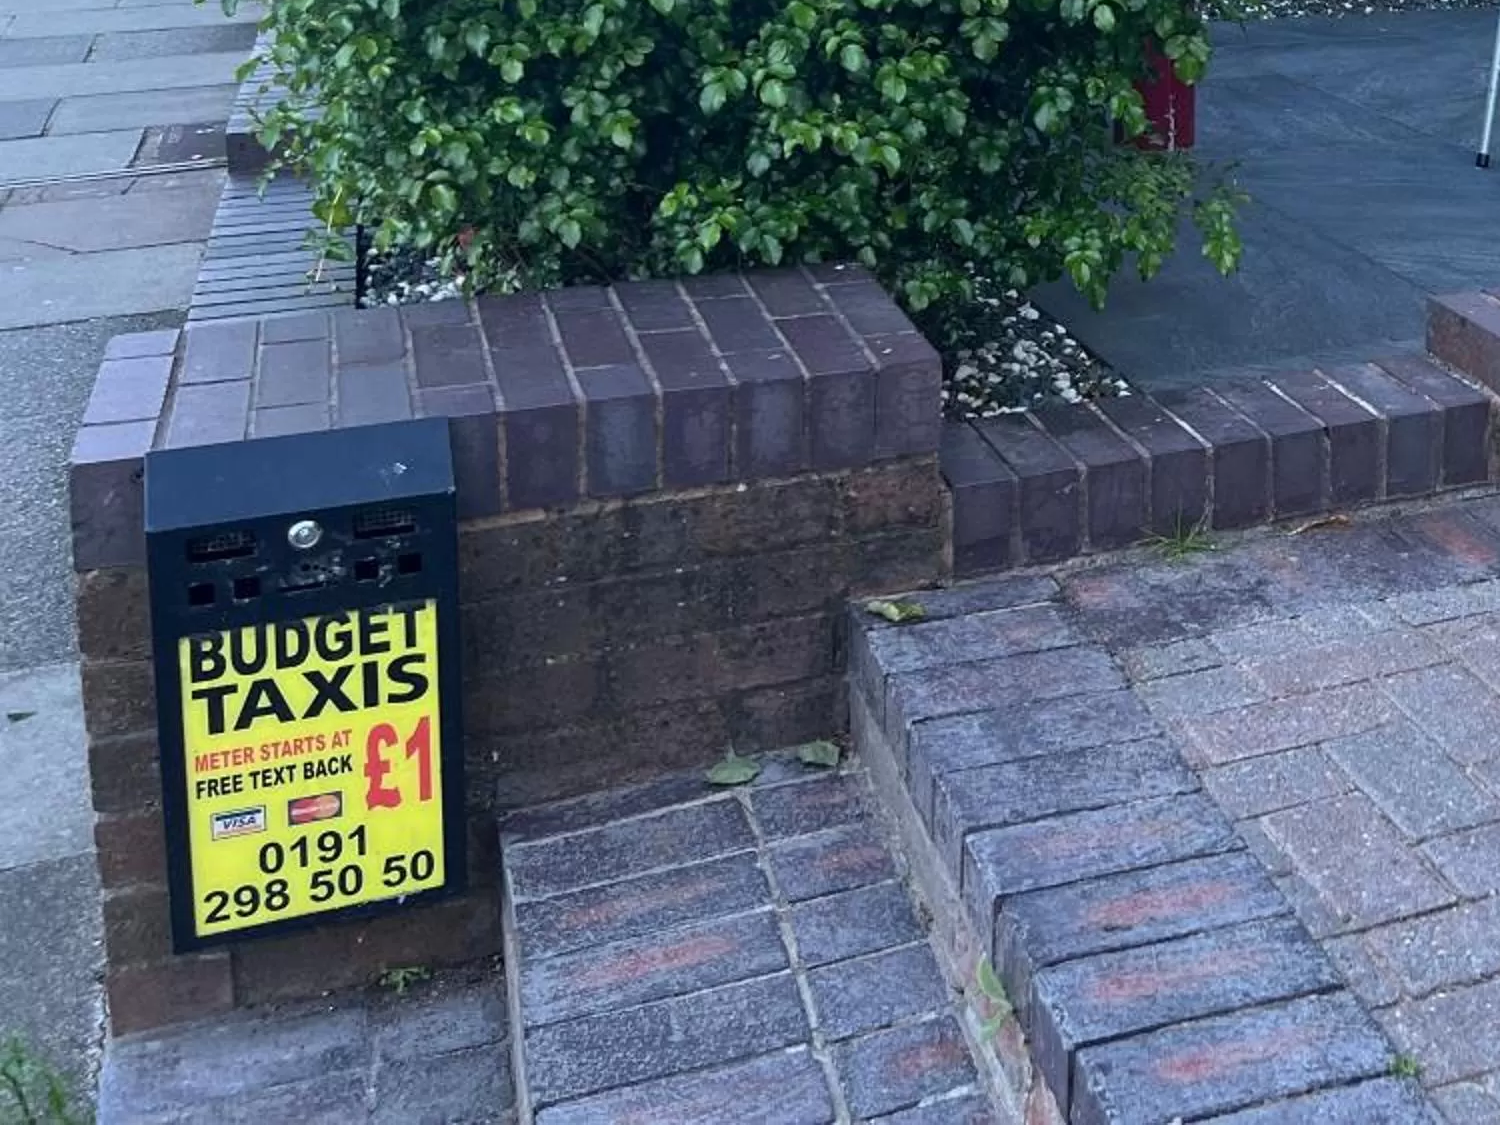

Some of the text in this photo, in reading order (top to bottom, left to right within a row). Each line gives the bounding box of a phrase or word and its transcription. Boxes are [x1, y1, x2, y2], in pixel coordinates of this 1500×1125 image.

[188, 602, 428, 684] BUDGET
[192, 653, 430, 735] TAXIS
[195, 729, 353, 773] METER STARTS AT
[195, 753, 353, 800] FREE TEXT BACK
[364, 715, 434, 811] £1
[222, 815, 257, 830] VISA
[259, 824, 368, 874] 0191
[203, 849, 435, 925] 298 50 50
